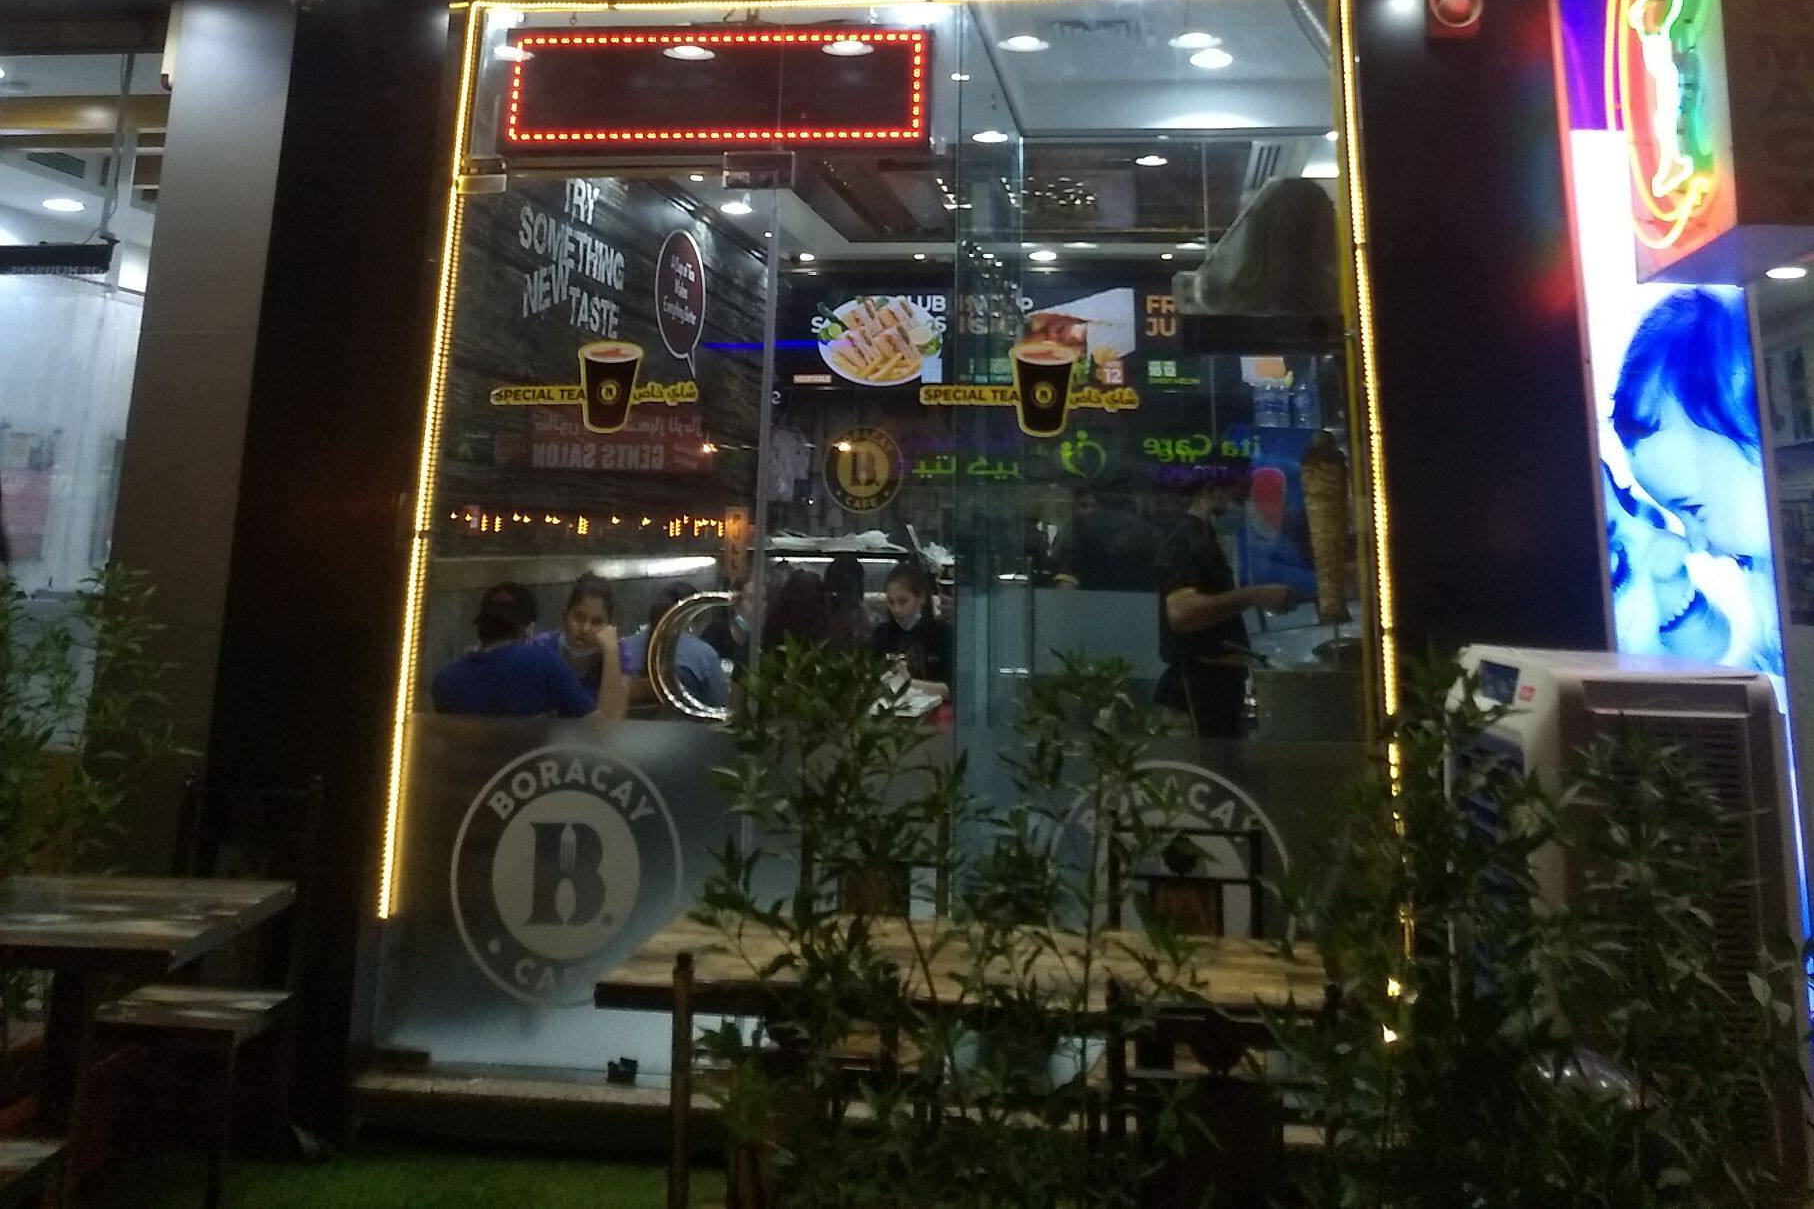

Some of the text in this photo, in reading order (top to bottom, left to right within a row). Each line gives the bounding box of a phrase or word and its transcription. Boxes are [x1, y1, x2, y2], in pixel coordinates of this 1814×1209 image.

[563, 178, 600, 226] TRY
[518, 206, 626, 292] SOMETHING
[522, 259, 575, 318] NEW
[568, 286, 620, 340] TASTE
[495, 388, 586, 401] SPECIAL TEA
[923, 388, 1021, 402] SPECIAL TEA
[485, 758, 656, 822] BORACAY
